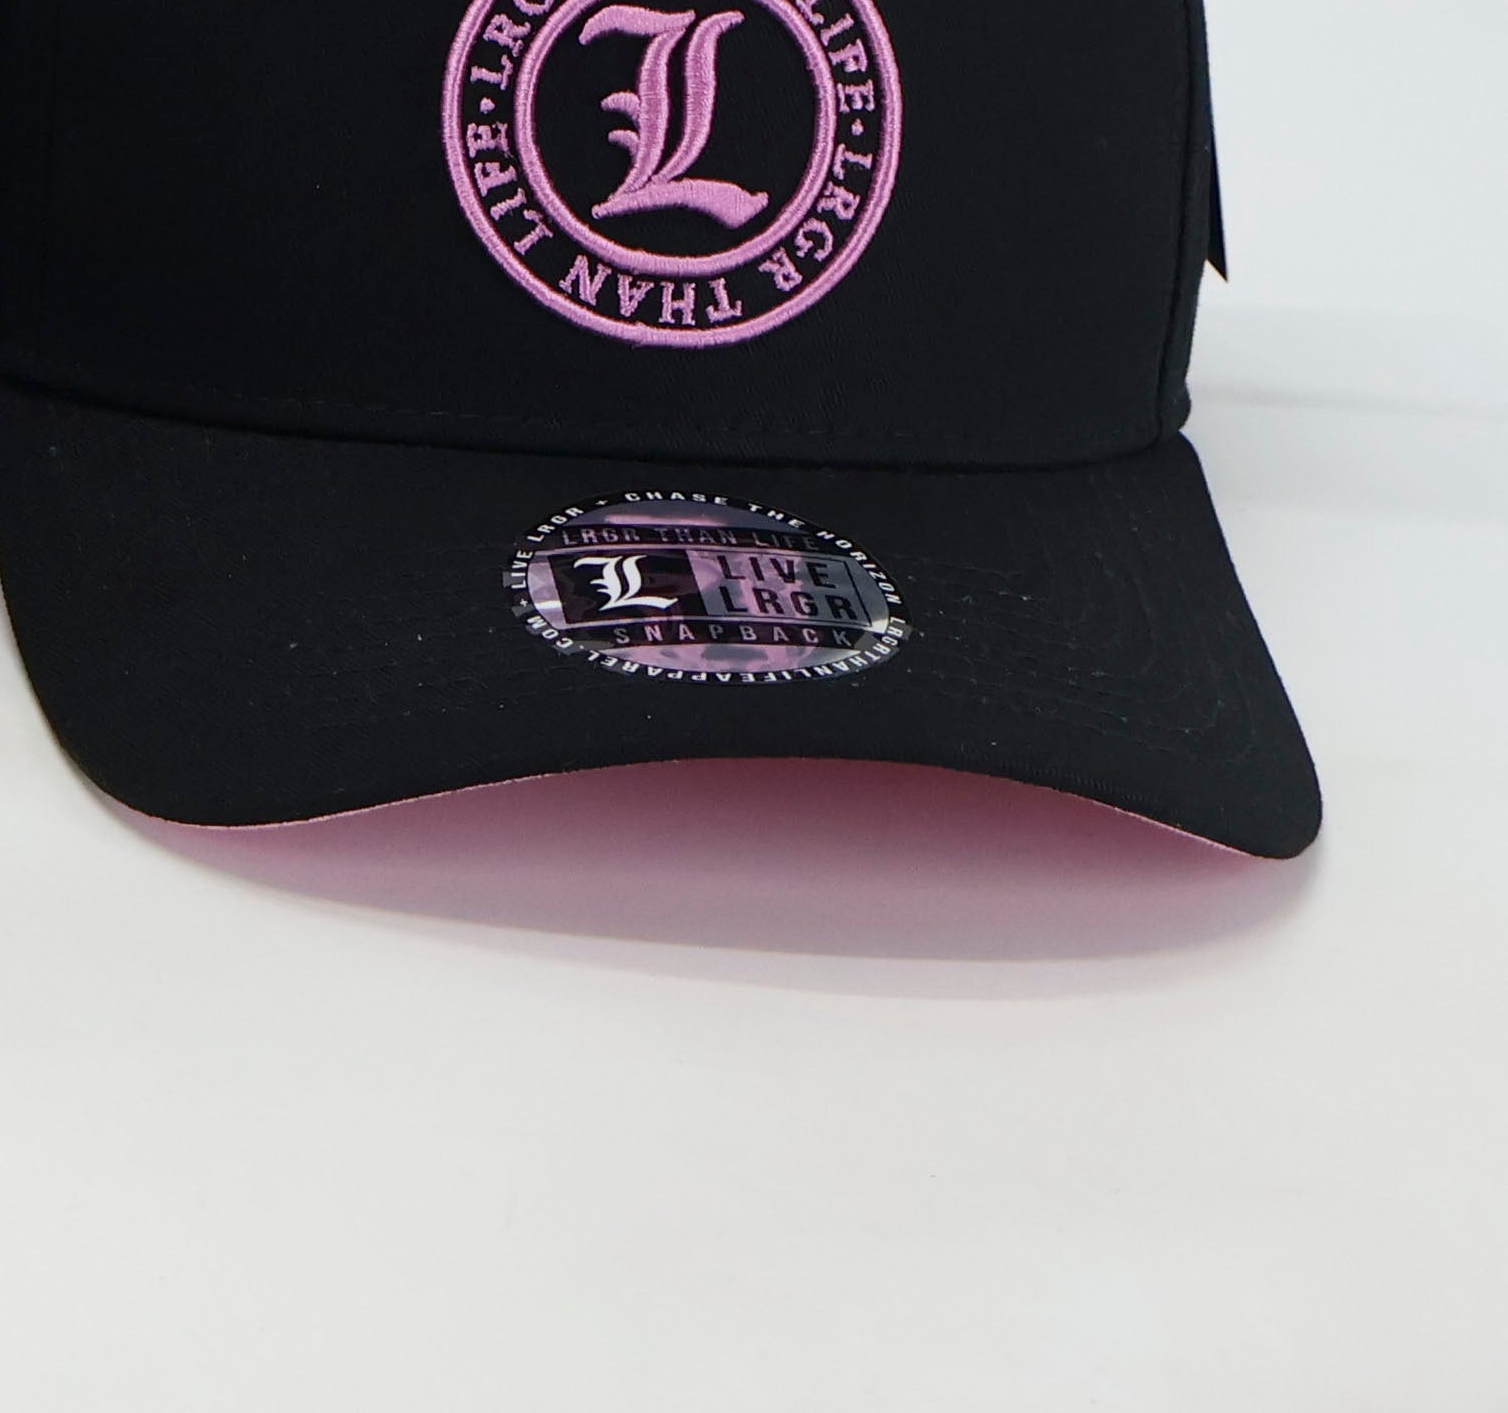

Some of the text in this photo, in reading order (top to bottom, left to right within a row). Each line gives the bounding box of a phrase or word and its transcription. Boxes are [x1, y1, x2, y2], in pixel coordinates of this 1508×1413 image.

[579, 5, 769, 229] L
[466, 122, 872, 325] LRGR THAN LIFE
[511, 506, 584, 589] LIVE LRGR
[624, 491, 902, 605] CHASE THE HORIZON
[655, 527, 737, 545] THAN
[573, 554, 679, 612] L
[717, 554, 837, 589] LIVE
[718, 585, 858, 621] LRGR
[615, 624, 853, 648] SNAPBACK
